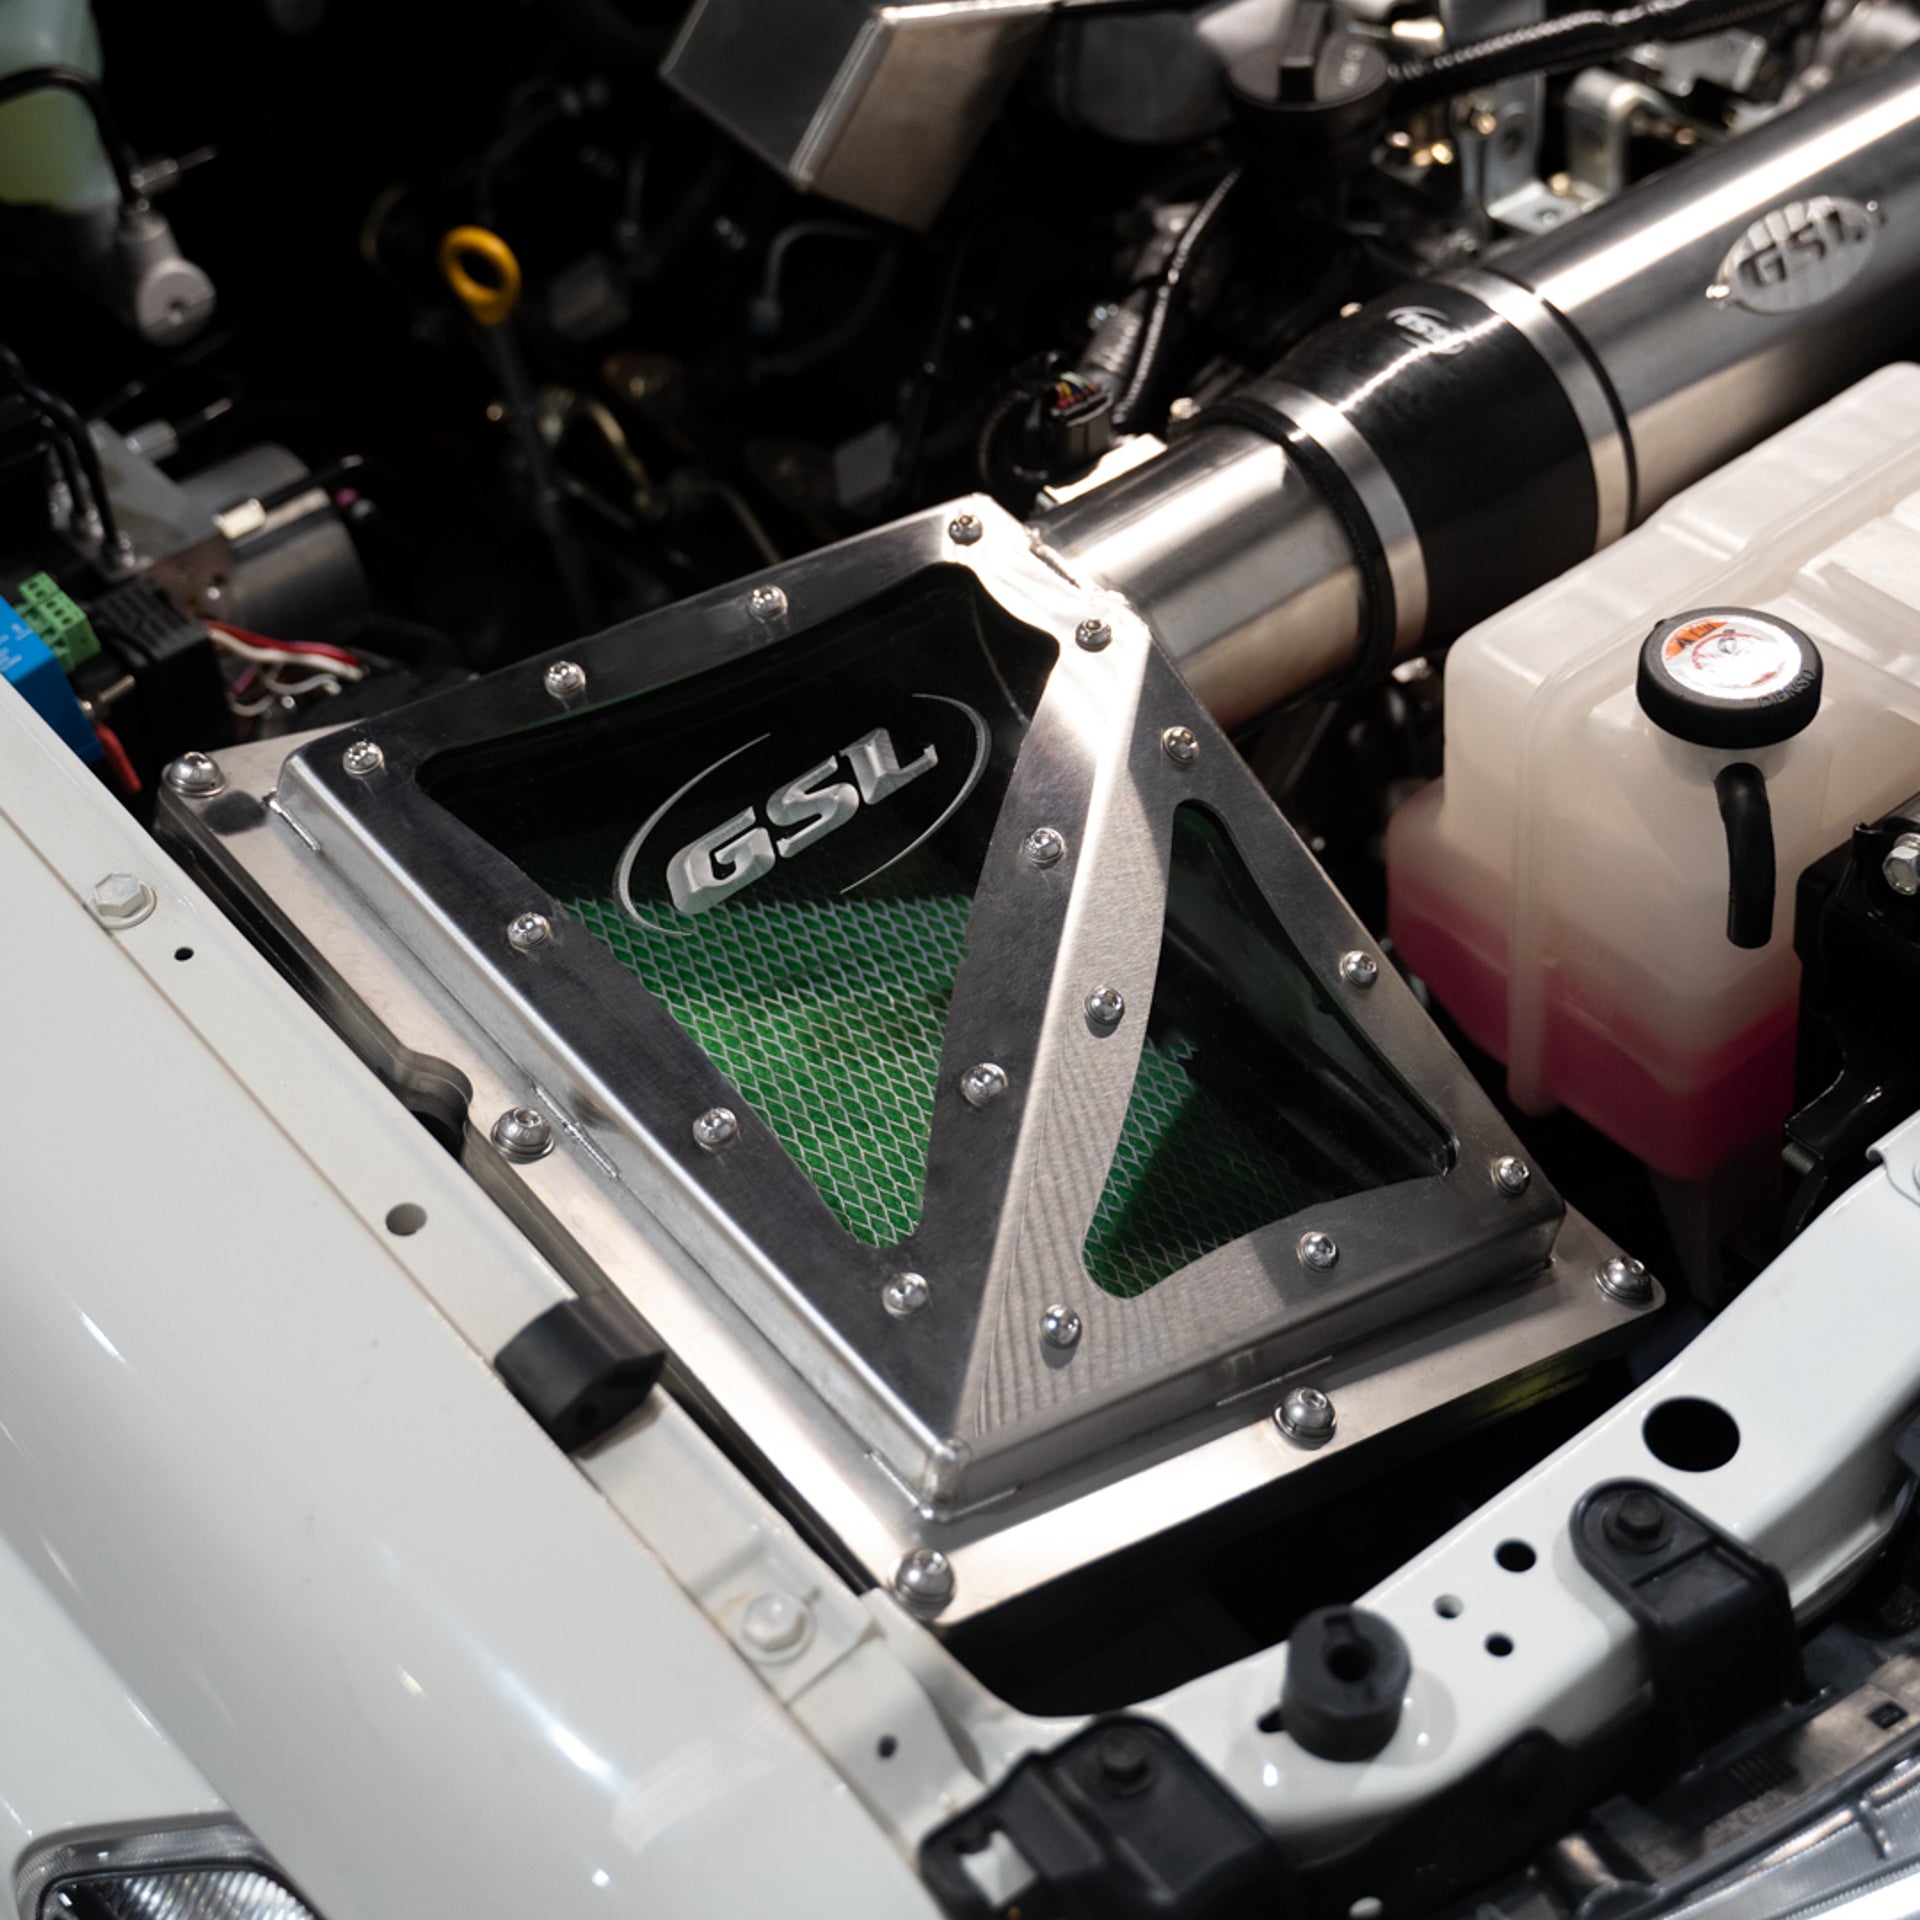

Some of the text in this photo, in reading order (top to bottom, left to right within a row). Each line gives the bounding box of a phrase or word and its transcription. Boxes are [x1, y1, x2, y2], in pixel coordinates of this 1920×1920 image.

[1736, 209, 1866, 288] GSL
[1758, 669, 1816, 708] DENSO
[666, 727, 939, 914] GSL
